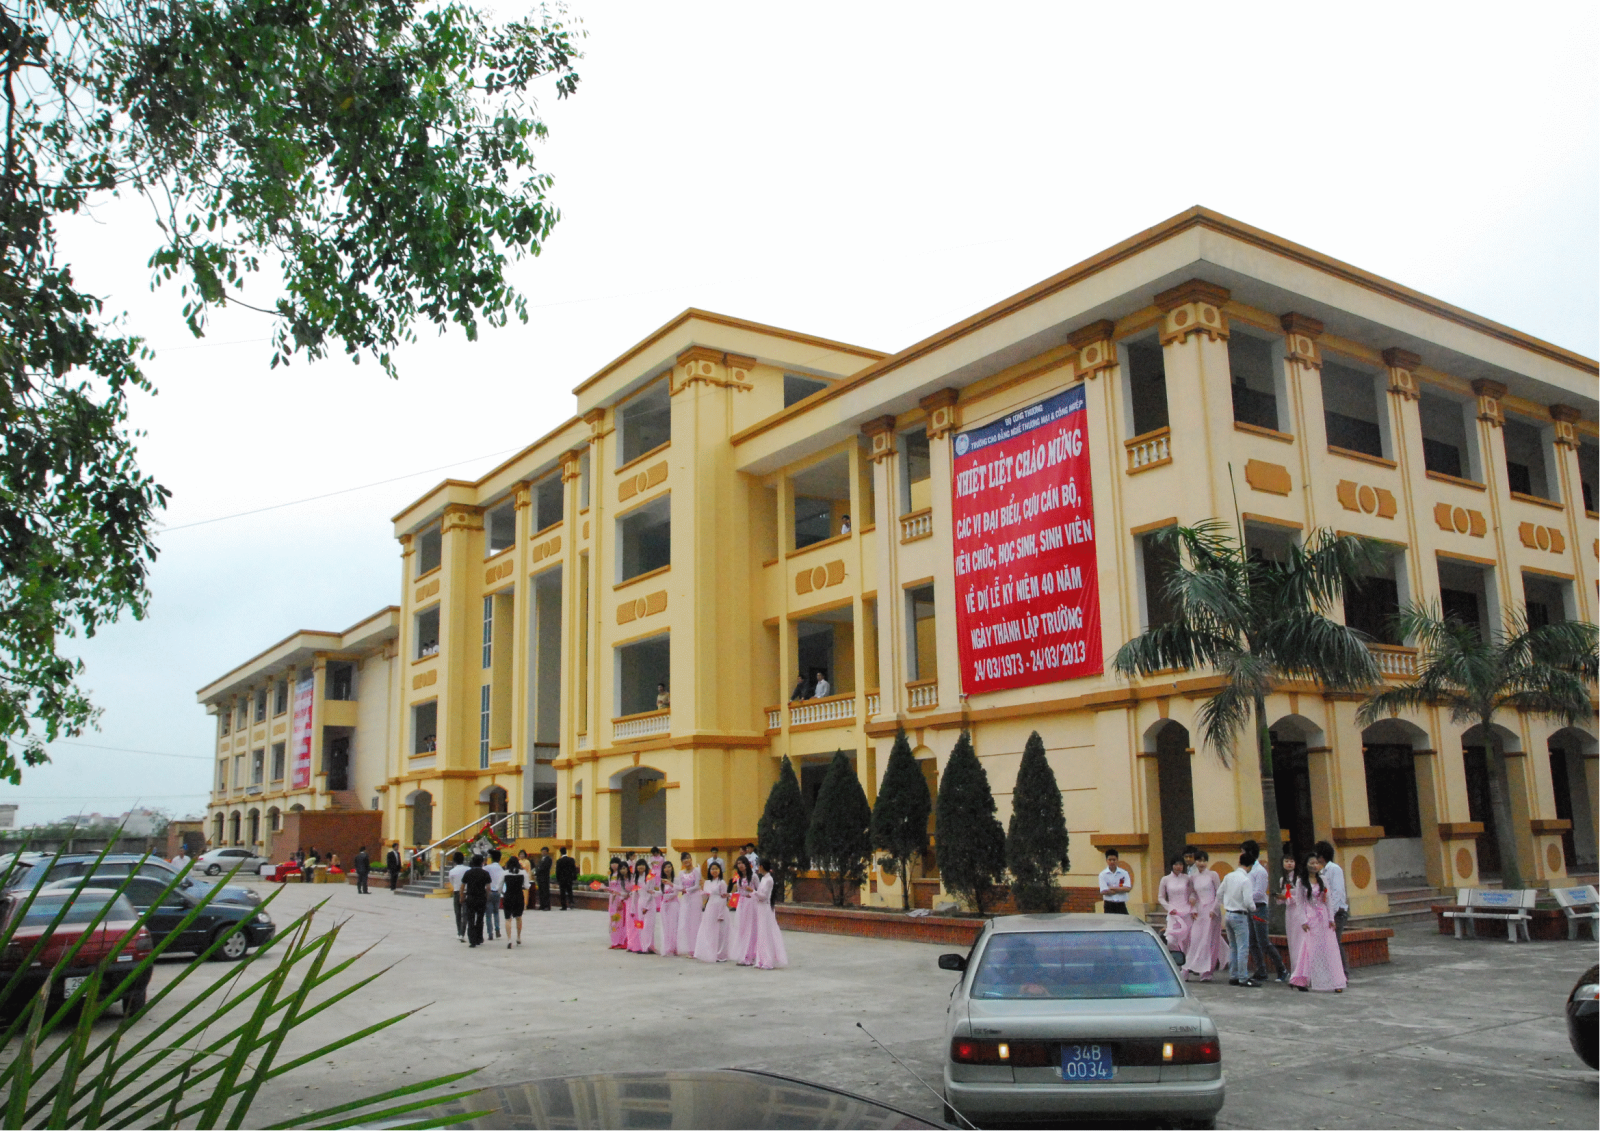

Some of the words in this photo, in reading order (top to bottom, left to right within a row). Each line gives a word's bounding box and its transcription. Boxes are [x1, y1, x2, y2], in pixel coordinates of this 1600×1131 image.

[956, 459, 987, 499] NHIỆT
[988, 451, 1014, 491] LIỆT
[1047, 428, 1083, 467] MỪNG
[956, 513, 972, 540] CÁC
[973, 513, 981, 538] VỊ
[983, 510, 999, 535] ĐẠI
[1001, 493, 1022, 527] BIỂU,
[1023, 492, 1040, 522] CỰU
[1040, 483, 1059, 512] CÁN
[1061, 477, 1082, 509] BỘ,
[955, 549, 971, 577] VIÊN
[972, 542, 997, 571] CHỨC,
[998, 540, 1015, 568] HỌC
[1016, 534, 1038, 558] SINH,
[1039, 523, 1063, 552] SINH
[1065, 514, 1093, 545] VIÊN
[965, 583, 976, 614] VỀ
[977, 583, 989, 614] DỰ
[990, 576, 1001, 609] LỄ
[1002, 575, 1014, 606] KỶ
[1016, 572, 1040, 604] NIỆM
[1041, 571, 1054, 596] 40
[1056, 564, 1083, 592] NĂM
[970, 622, 992, 650] NGÀY
[993, 617, 1022, 646] THÀNH
[1021, 611, 1040, 643] LẬP
[1040, 604, 1083, 635] TRƯỜNG
[973, 652, 1025, 682] 24/03/1973
[1067, 1061, 1107, 1078] 0034
[1072, 1044, 1102, 1061] 34B
